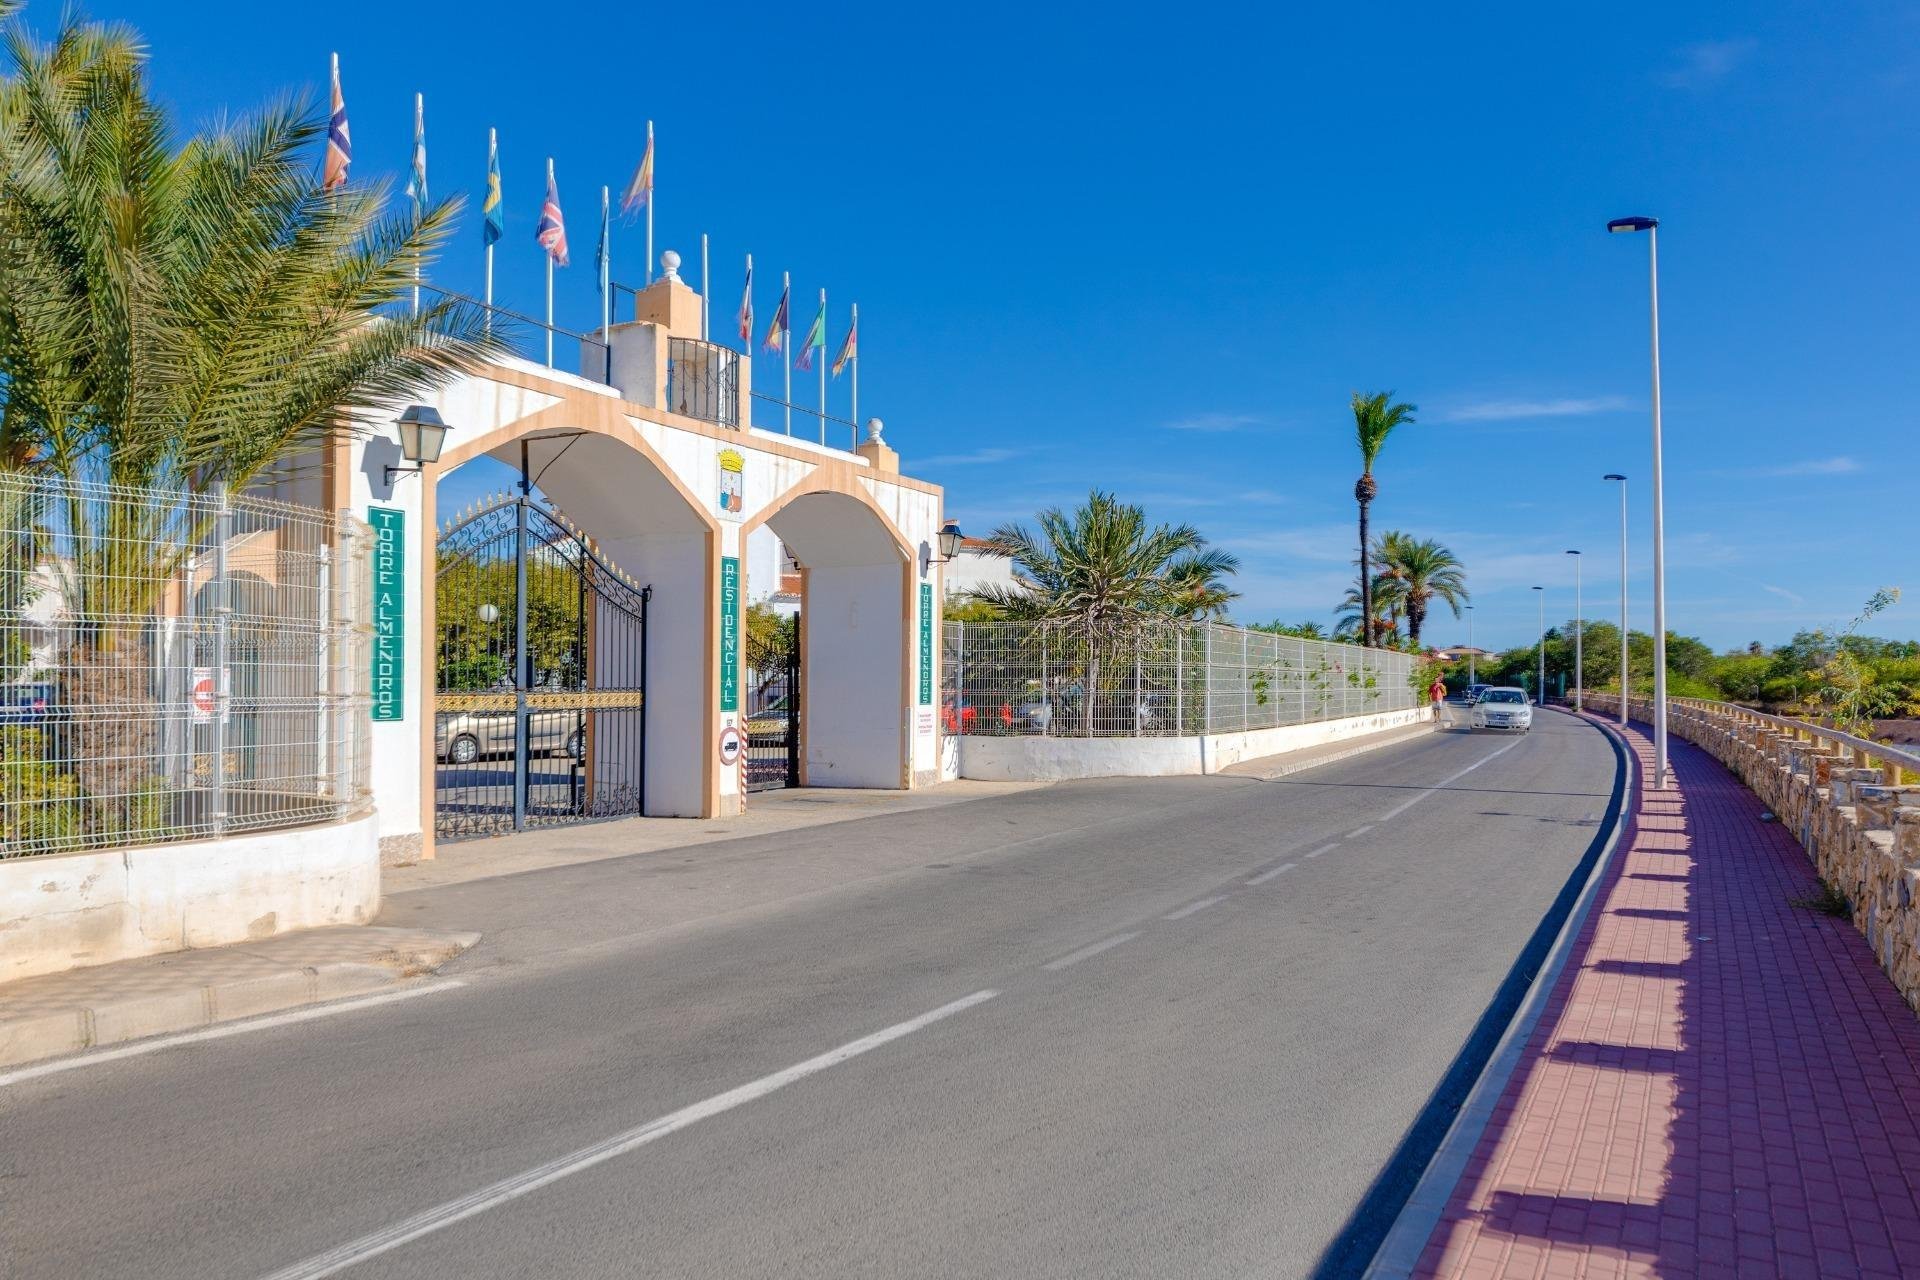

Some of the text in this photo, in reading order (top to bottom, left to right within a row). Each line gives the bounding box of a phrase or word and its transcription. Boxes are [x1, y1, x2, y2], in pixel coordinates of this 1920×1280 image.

[379, 513, 394, 719] TORRE ALMENDROS
[725, 564, 734, 702] RESIDENCIAL
